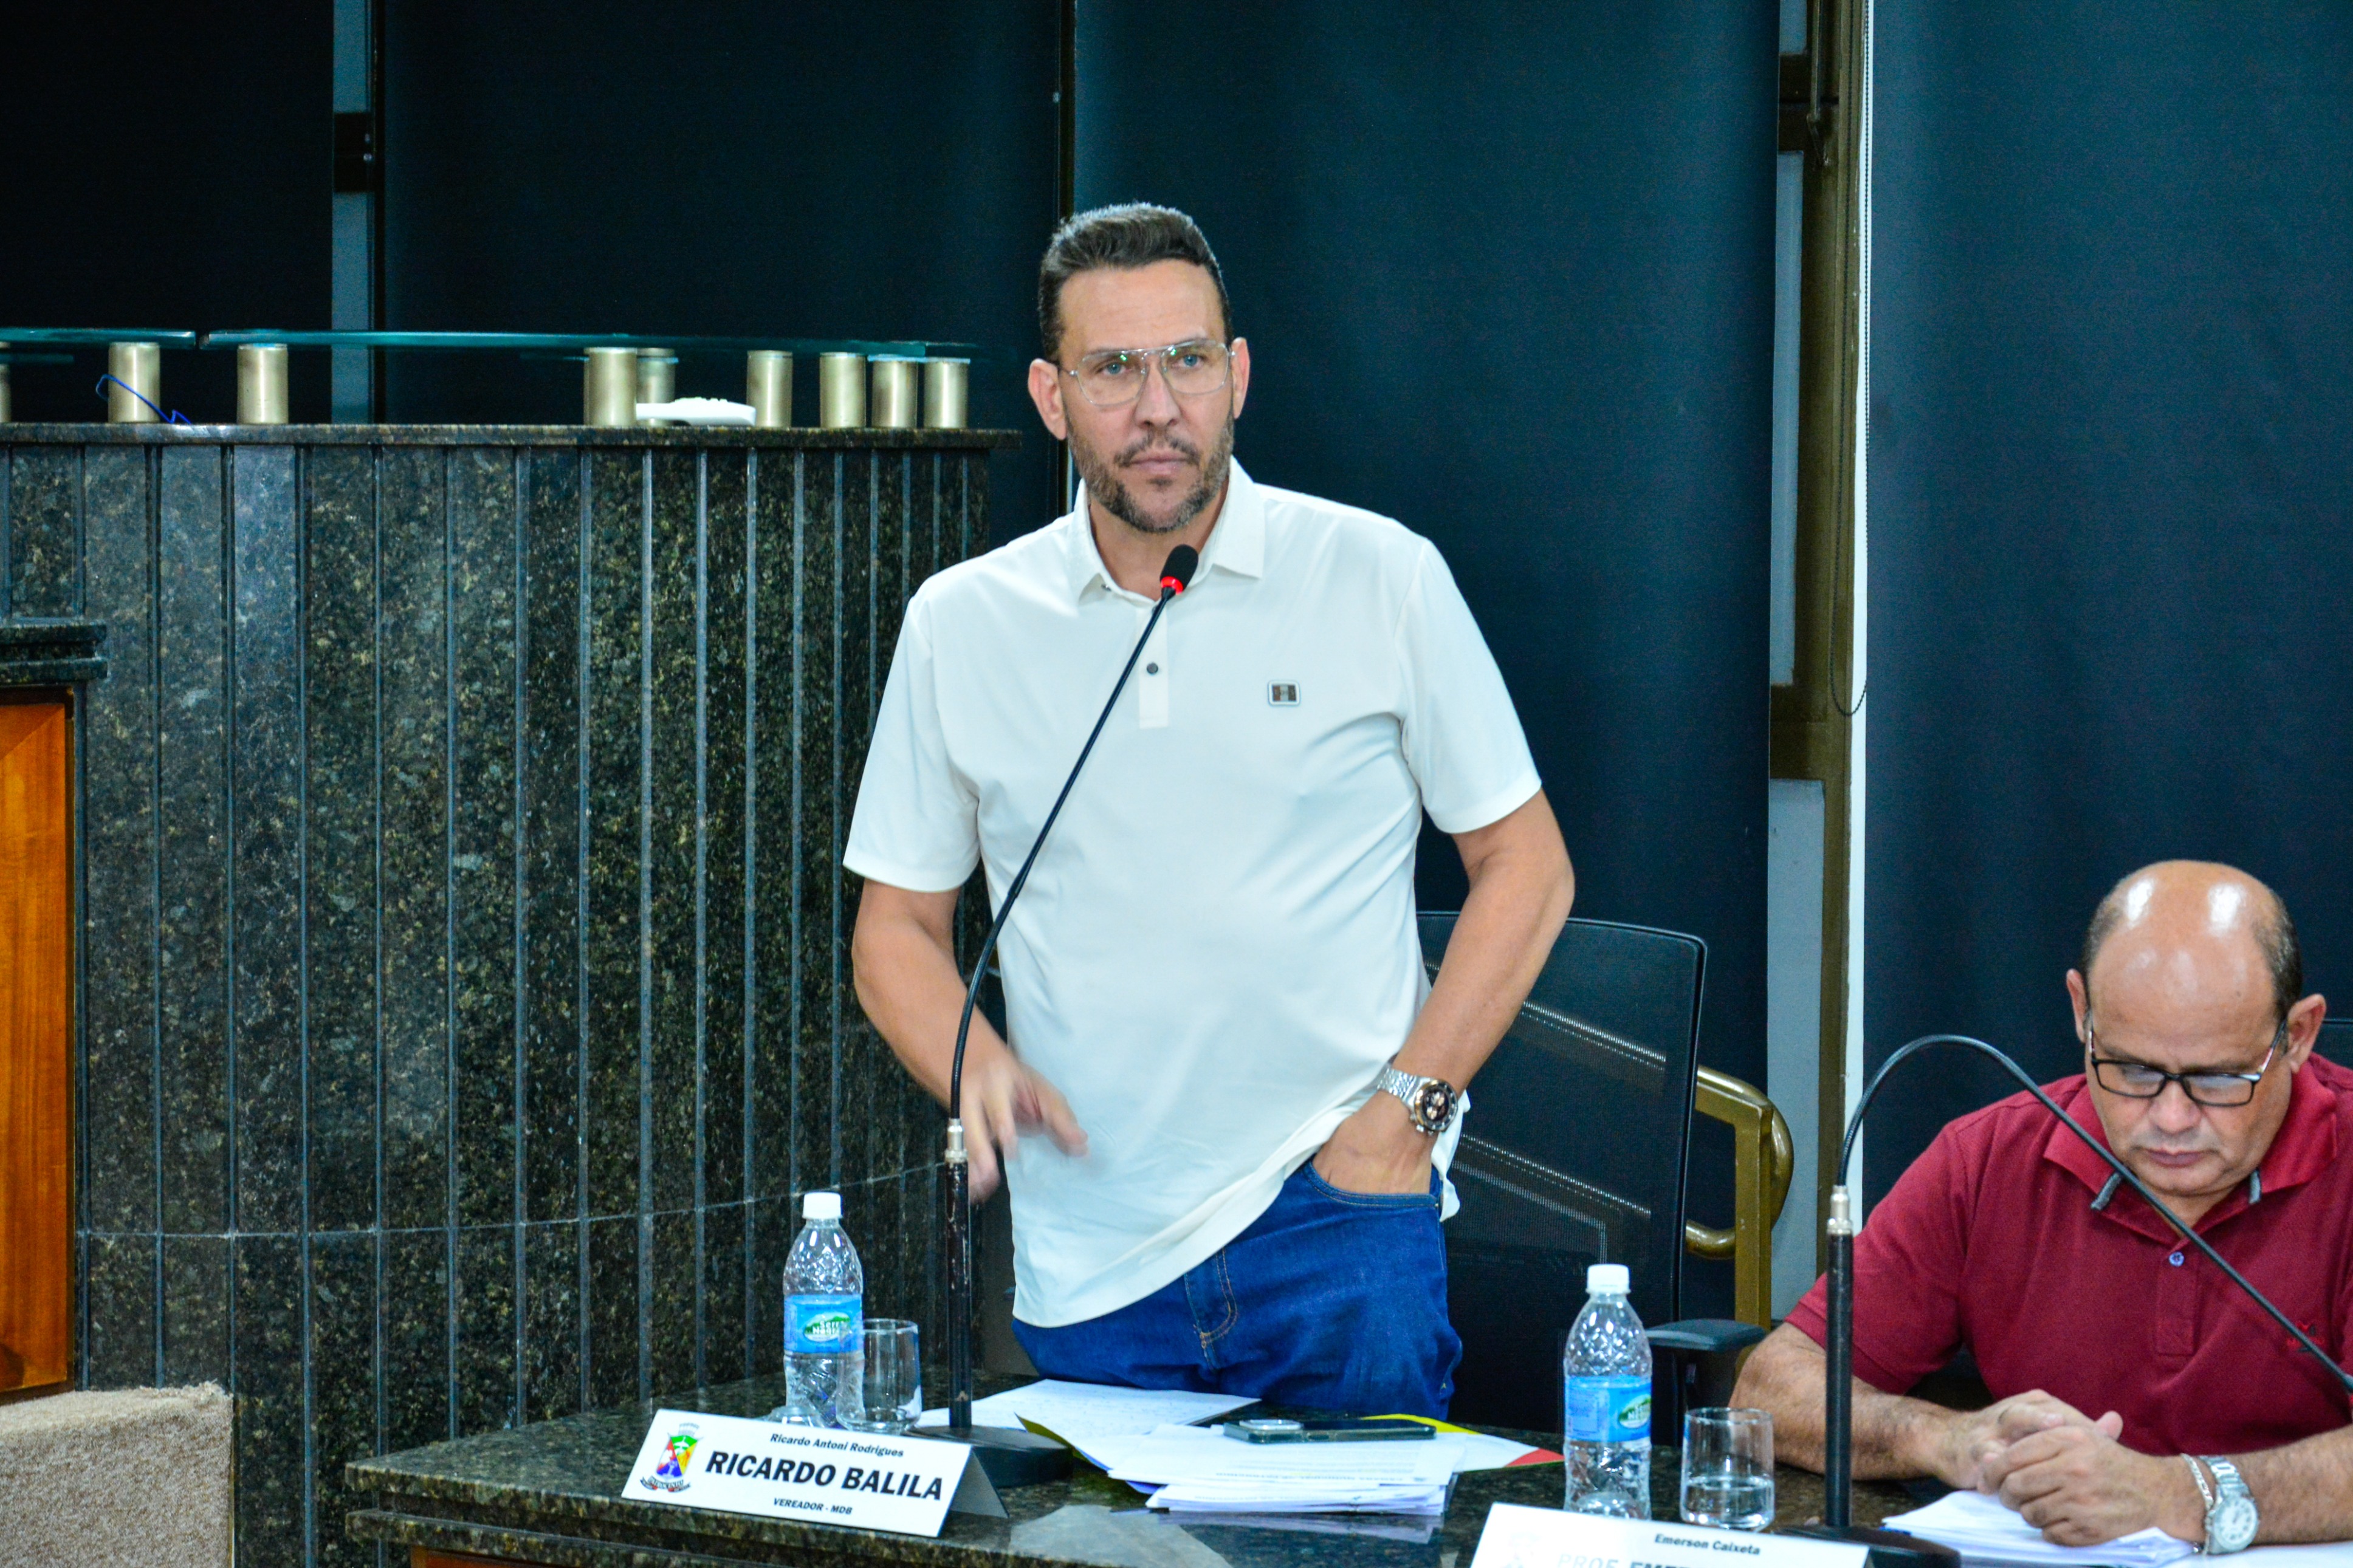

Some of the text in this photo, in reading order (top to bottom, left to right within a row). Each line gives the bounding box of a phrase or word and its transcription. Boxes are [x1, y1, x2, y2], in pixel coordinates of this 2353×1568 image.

[770, 1434, 904, 1456] Ricardo Antoni Rodrigues
[706, 1451, 943, 1501] RICARDO BALILA
[774, 1498, 823, 1512] VEREADOR
[831, 1505, 852, 1515] MDB
[1655, 1534, 1760, 1555] Emerson Caixeta
